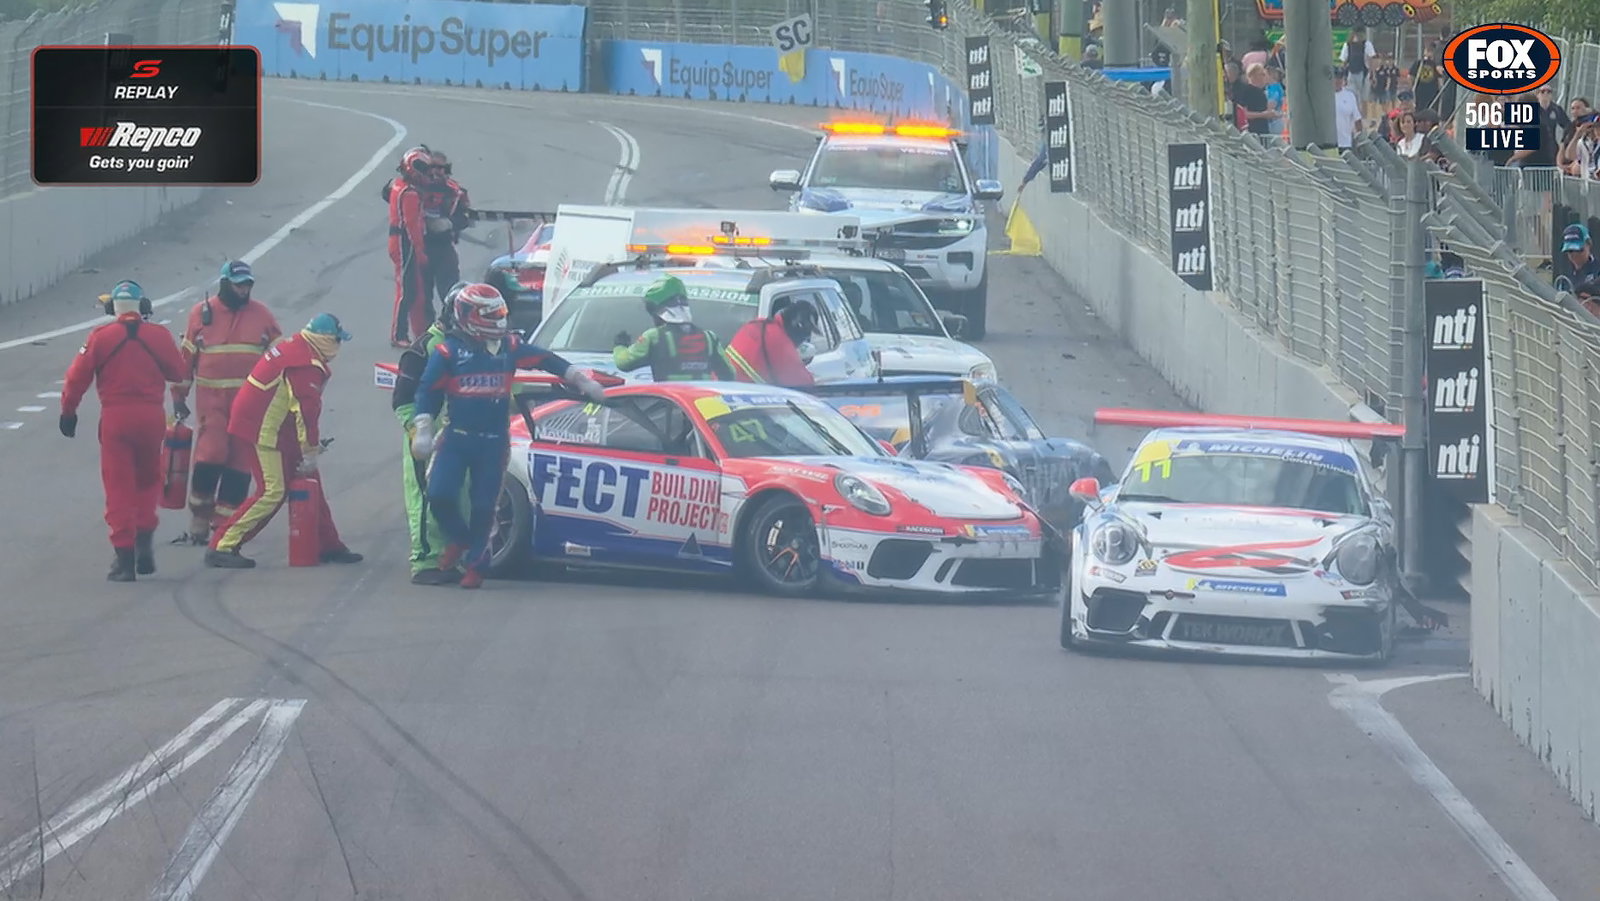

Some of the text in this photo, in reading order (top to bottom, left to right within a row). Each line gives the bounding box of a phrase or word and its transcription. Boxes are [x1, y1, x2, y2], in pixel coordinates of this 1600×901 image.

[776, 20, 811, 50] SC
[969, 45, 988, 62] nti
[971, 70, 990, 88] nti
[973, 96, 991, 115] nti
[1049, 93, 1065, 114] nti
[1050, 124, 1067, 145] nti
[1052, 158, 1069, 178] nti
[1174, 159, 1203, 186] nti
[1176, 200, 1205, 228] nti
[1178, 245, 1206, 272] nti
[687, 287, 750, 301] ASSION
[1433, 304, 1477, 344] nti
[1435, 367, 1479, 407] nti
[729, 418, 768, 443] 47
[1210, 444, 1323, 461] MICHELIN
[1437, 434, 1480, 473] nti
[1134, 460, 1171, 482] 11
[528, 453, 650, 519] FECT
[651, 471, 720, 505] BUILDIN
